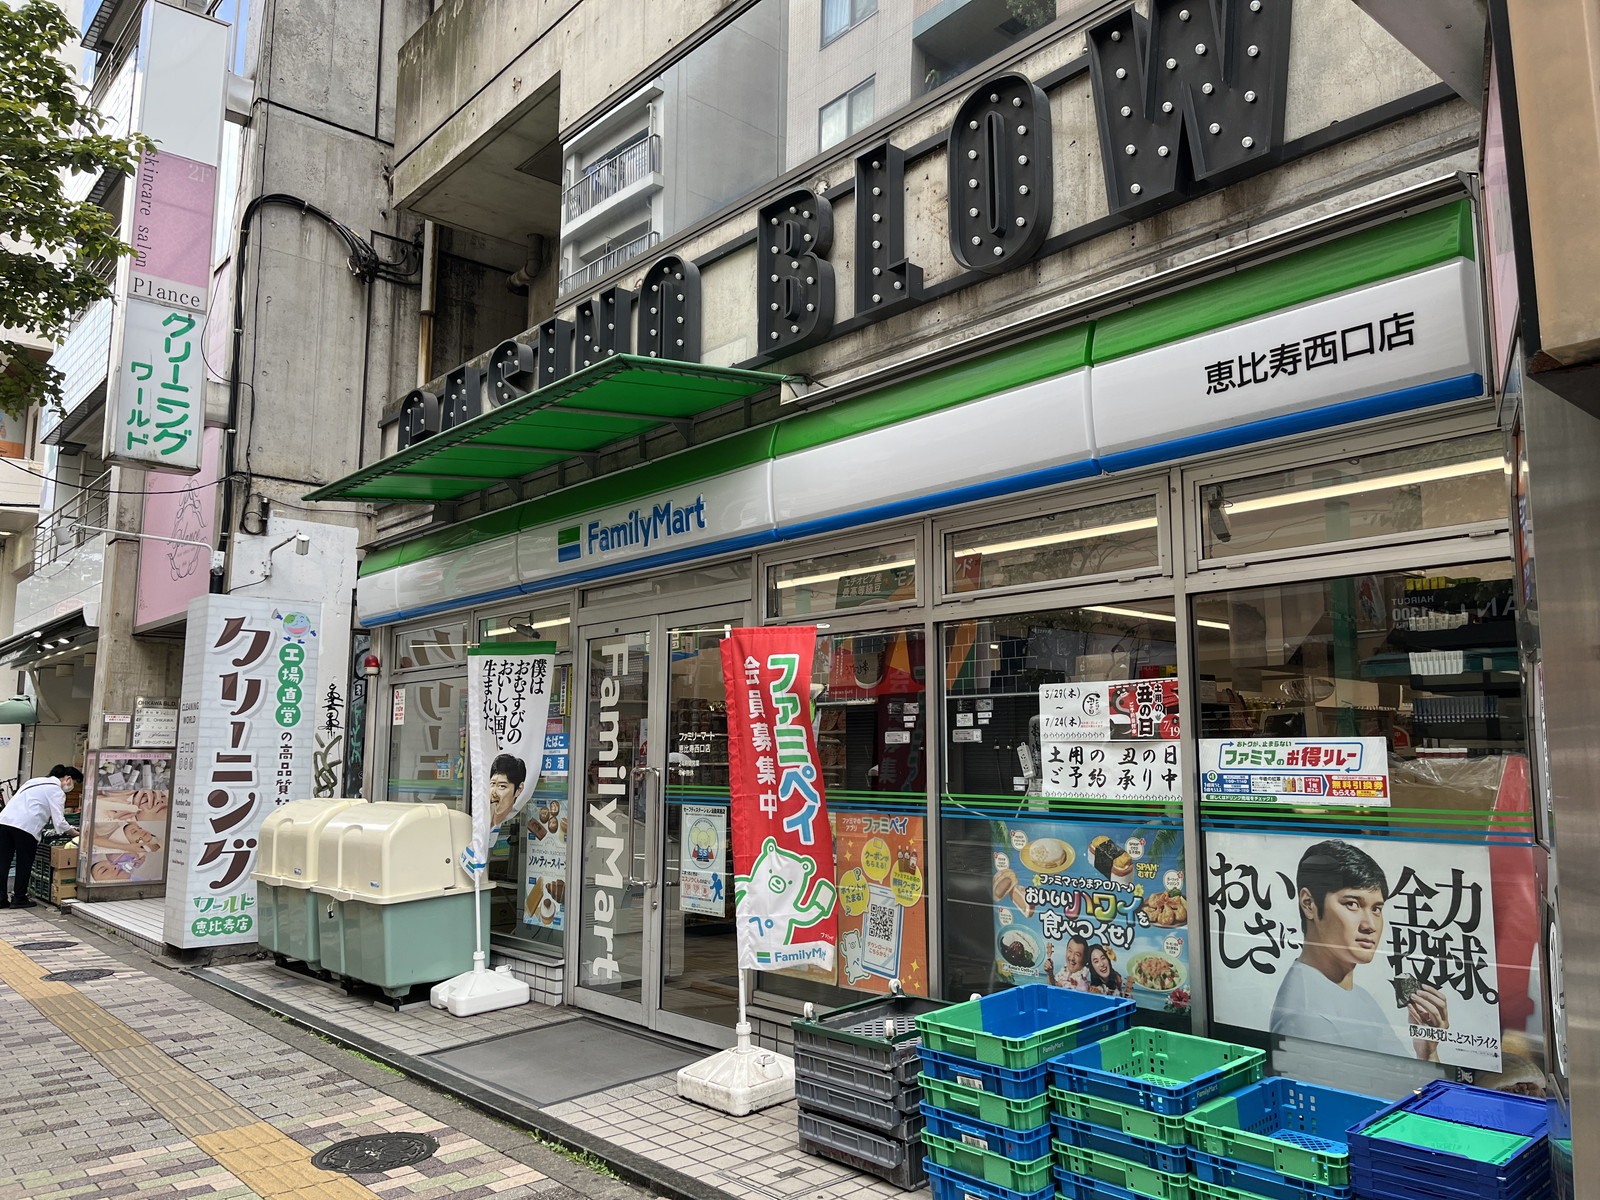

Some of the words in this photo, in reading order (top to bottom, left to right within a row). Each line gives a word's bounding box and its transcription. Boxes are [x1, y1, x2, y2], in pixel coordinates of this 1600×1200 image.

[140, 150, 160, 216] skincare
[188, 162, 212, 184] 2F
[757, 0, 1293, 358] BLOW
[135, 225, 152, 268] salon
[134, 277, 201, 308] Plance
[1204, 311, 1415, 396] 恵比寿西口店
[153, 312, 196, 456] クリーニング
[127, 361, 153, 451] ワールド
[588, 494, 707, 555] FamilyMart
[529, 658, 547, 695] 僕は
[182, 702, 200, 712] CLEANING
[507, 659, 531, 745] おむすびの
[1045, 688, 1081, 699] 5/29(木)
[1154, 684, 1163, 712] 土用の
[1045, 716, 1082, 728] 7/24(木)
[1139, 685, 1163, 736] 丑の日
[545, 735, 564, 748] たばこ
[678, 731, 715, 741] ファミリーマート
[743, 655, 779, 820] 会員募集中
[1163, 720, 1180, 737] 7/19
[196, 616, 271, 890] クリーニング
[679, 744, 711, 753] 恵比寿西口店
[767, 654, 819, 842] ファミペイ
[1225, 747, 1357, 767] ファミマのお得リレー
[1332, 780, 1383, 790] 無料引換券
[590, 643, 628, 980] FamilyMart
[862, 817, 908, 835] ファミペイ
[1136, 863, 1158, 872] SPAM
[1208, 852, 1296, 911] おい
[193, 896, 255, 914] ワールド
[1389, 866, 1483, 933] 全力
[195, 916, 249, 934] 恵比寿店
[1040, 911, 1134, 949] 食べつくせ!
[1043, 1042, 1065, 1053] FamilyMart
[1197, 1084, 1218, 1098] FamilyMart
